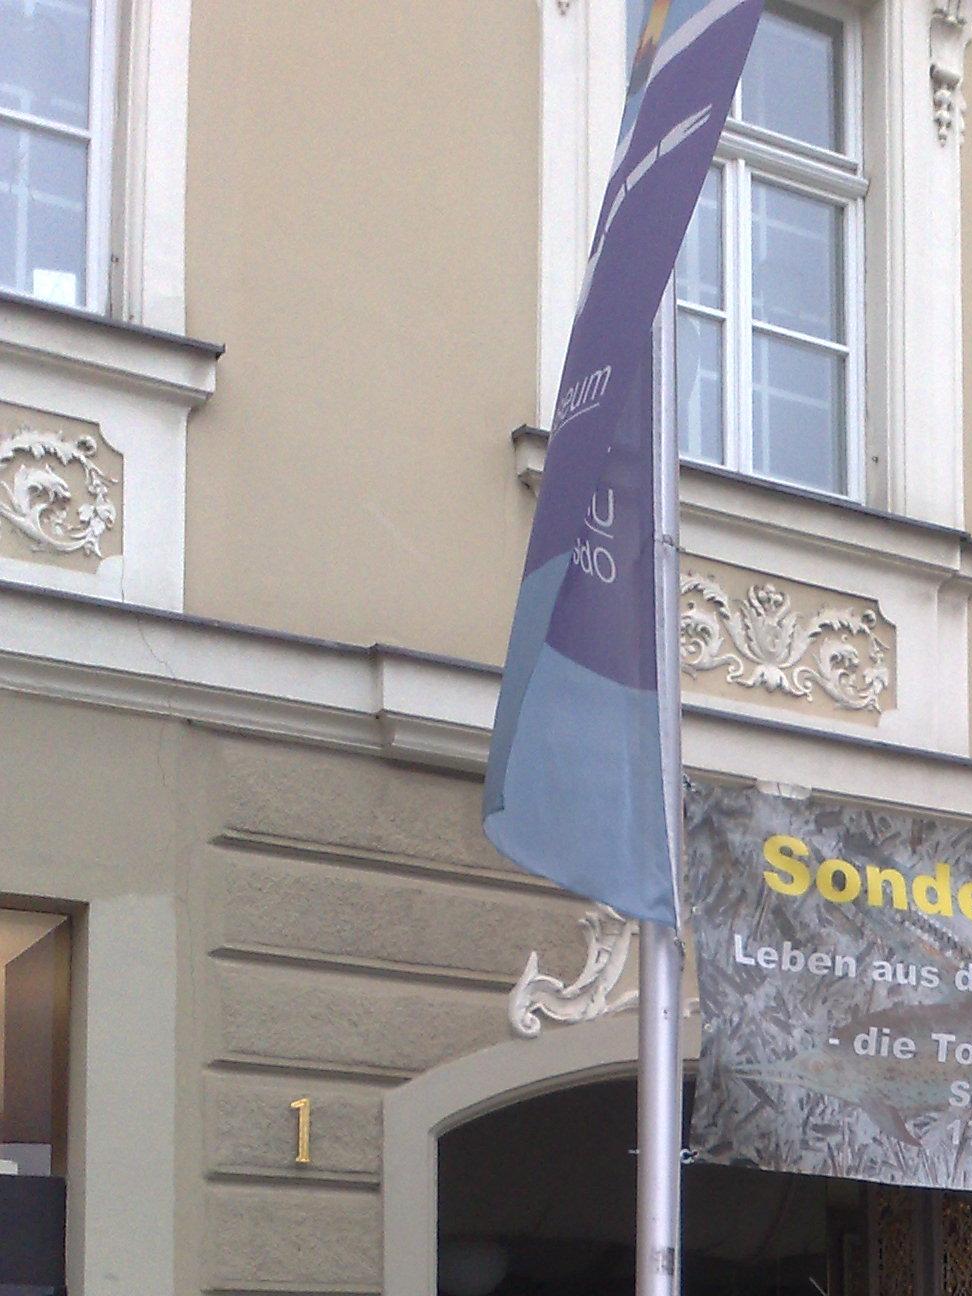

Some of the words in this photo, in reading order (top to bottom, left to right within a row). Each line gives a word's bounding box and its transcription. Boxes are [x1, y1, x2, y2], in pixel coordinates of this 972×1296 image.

[734, 934, 857, 978] Leben
[871, 958, 940, 989] aus
[853, 1027, 917, 1059] die
[290, 1097, 311, 1163] 1
